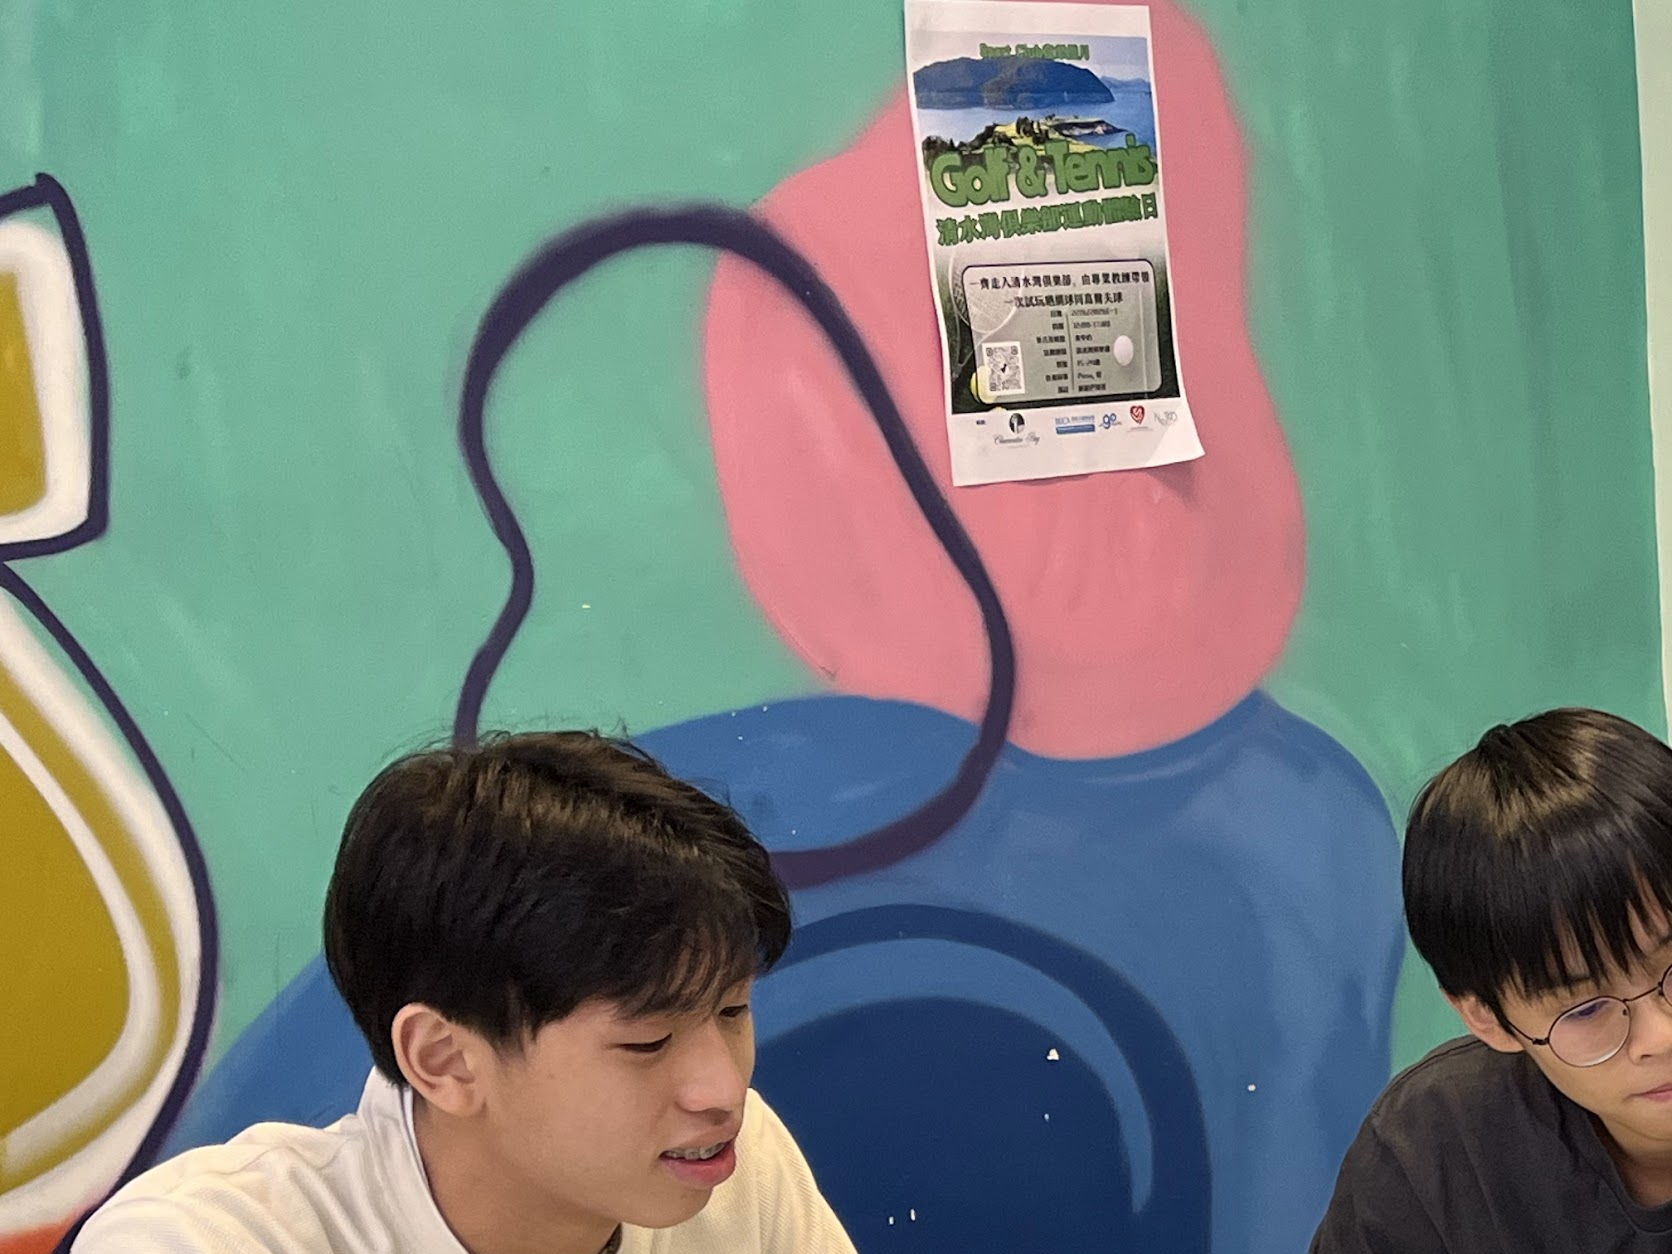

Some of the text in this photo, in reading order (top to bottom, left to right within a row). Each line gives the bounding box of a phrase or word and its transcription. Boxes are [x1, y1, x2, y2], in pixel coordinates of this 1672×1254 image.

[930, 133, 1158, 207] Golf & Tennis
